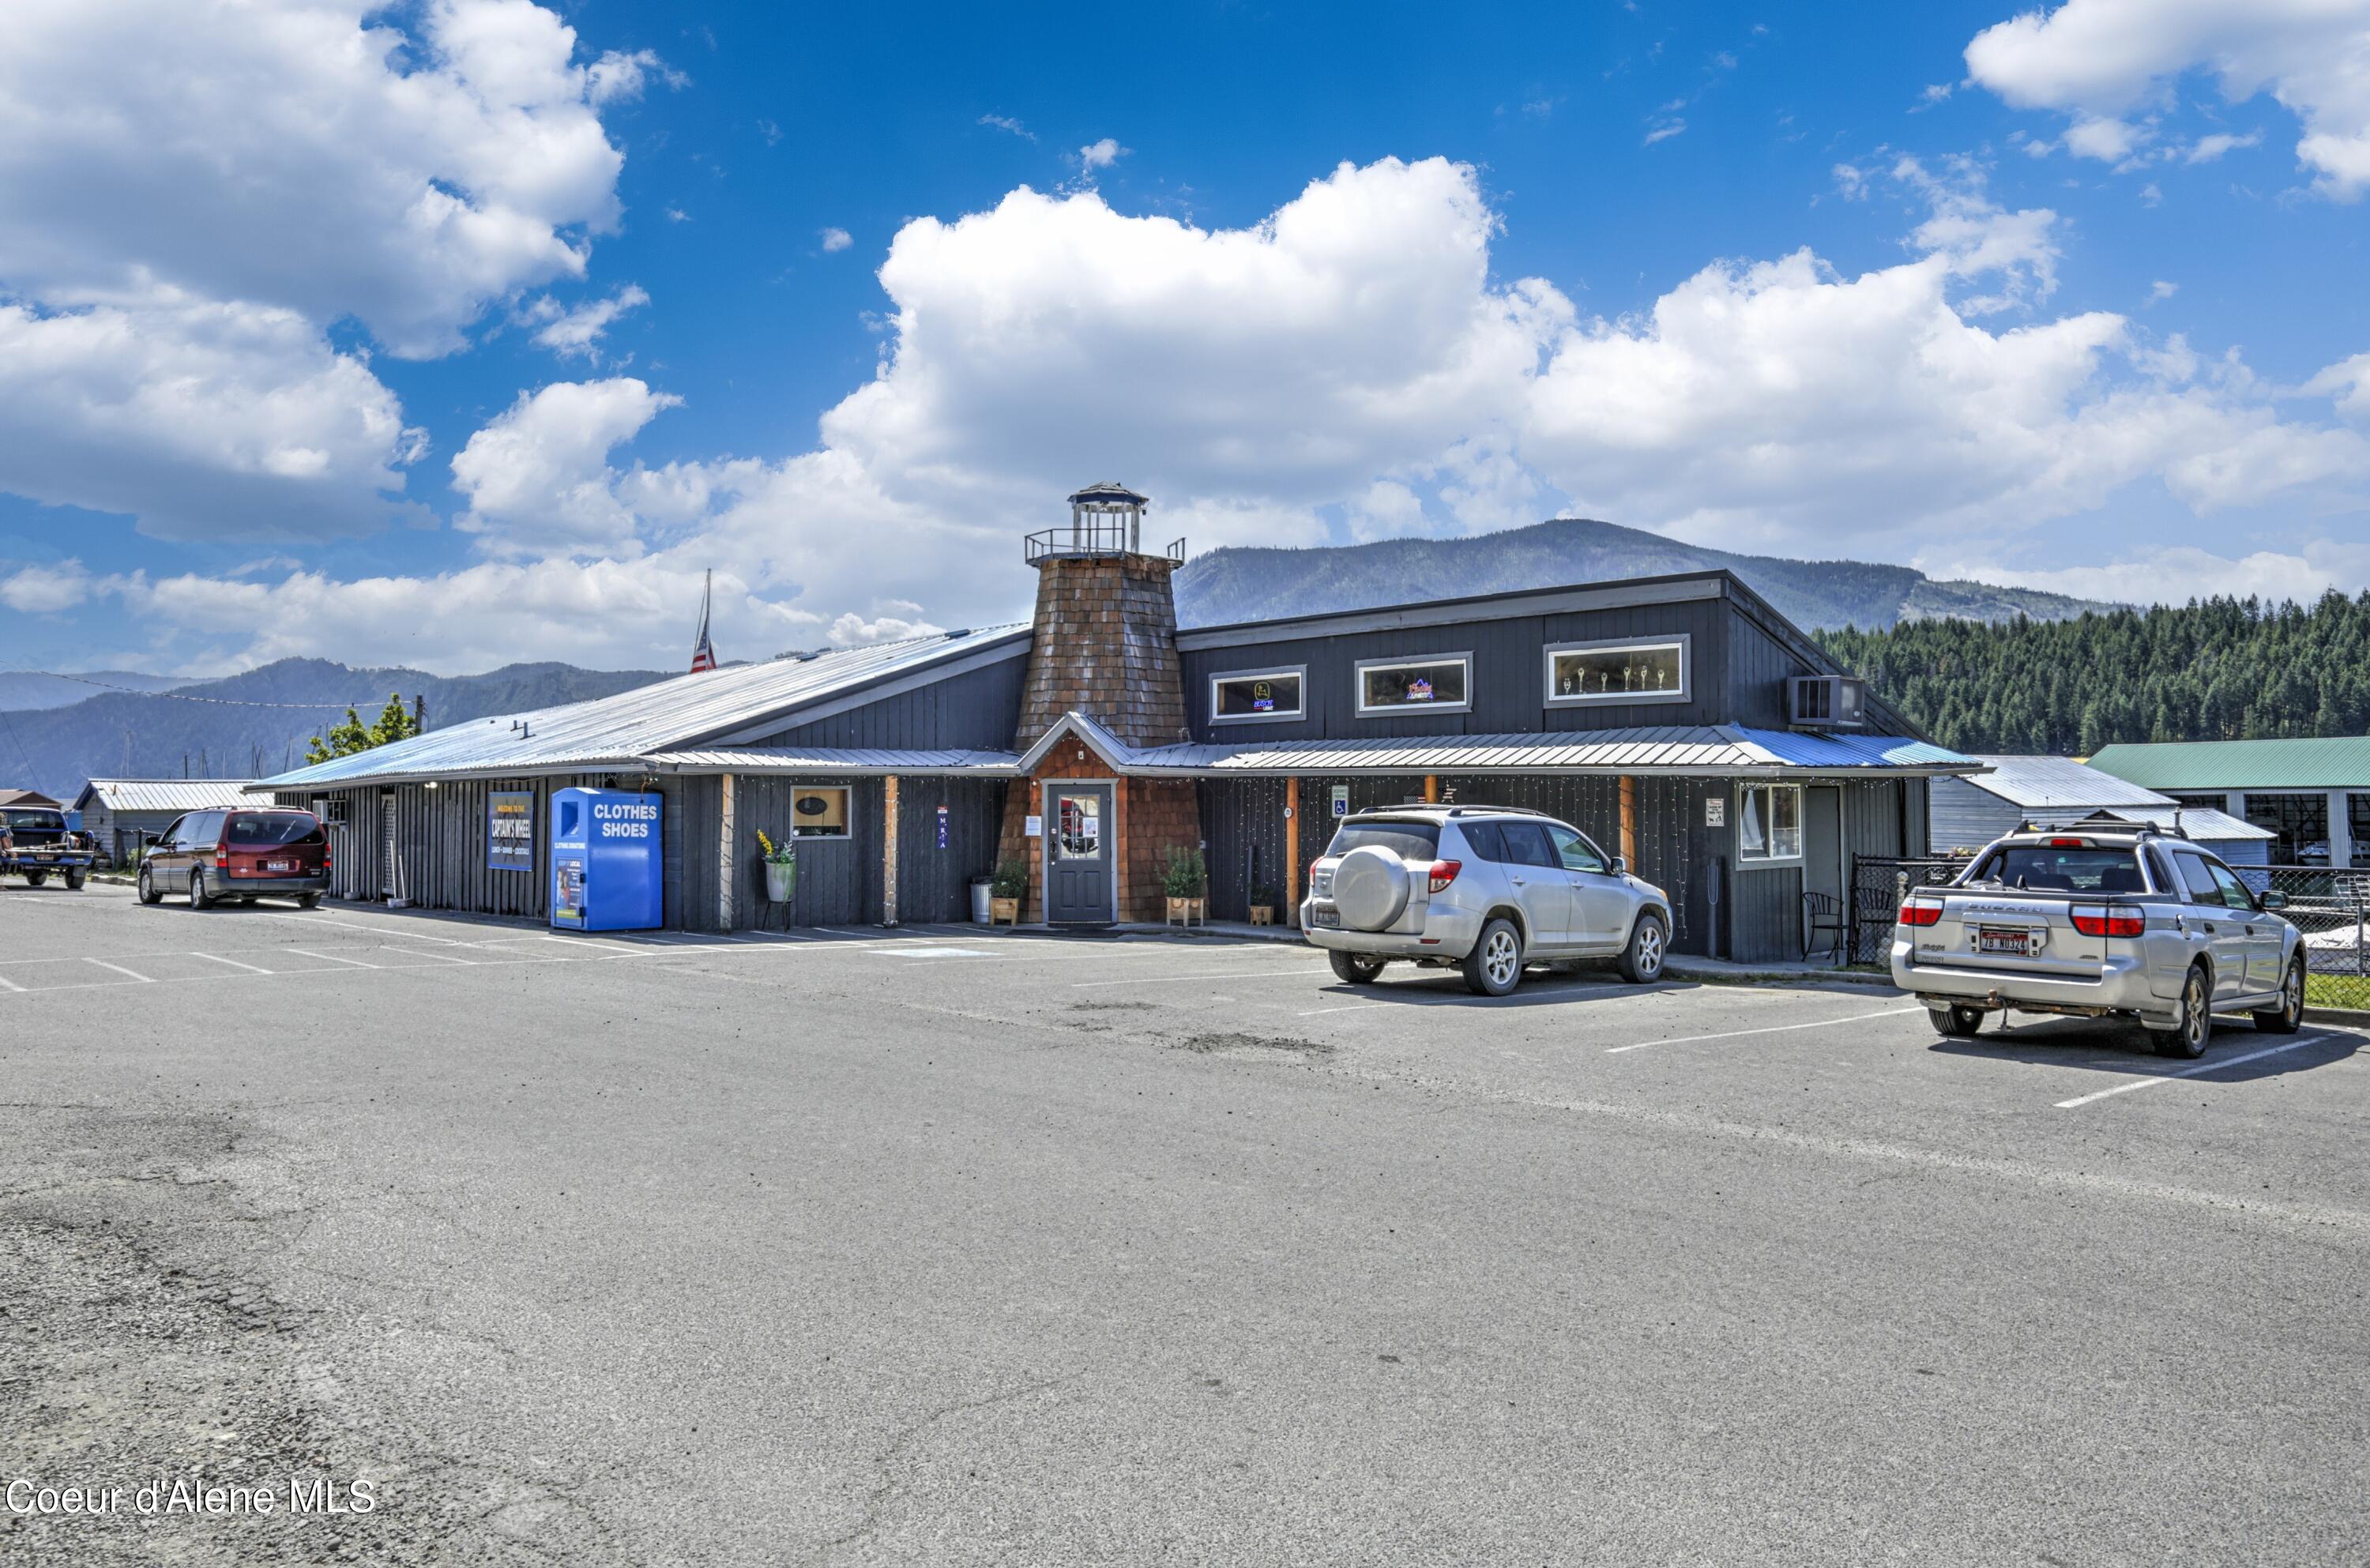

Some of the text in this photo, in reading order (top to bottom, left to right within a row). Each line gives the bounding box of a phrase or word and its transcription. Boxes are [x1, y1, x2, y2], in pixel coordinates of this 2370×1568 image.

[594, 804, 657, 820] CLOTHES
[492, 818, 531, 838] CAPTAIN'S WHEEL
[602, 822, 648, 837] SHOES
[1984, 938, 2025, 950] 7B N0324
